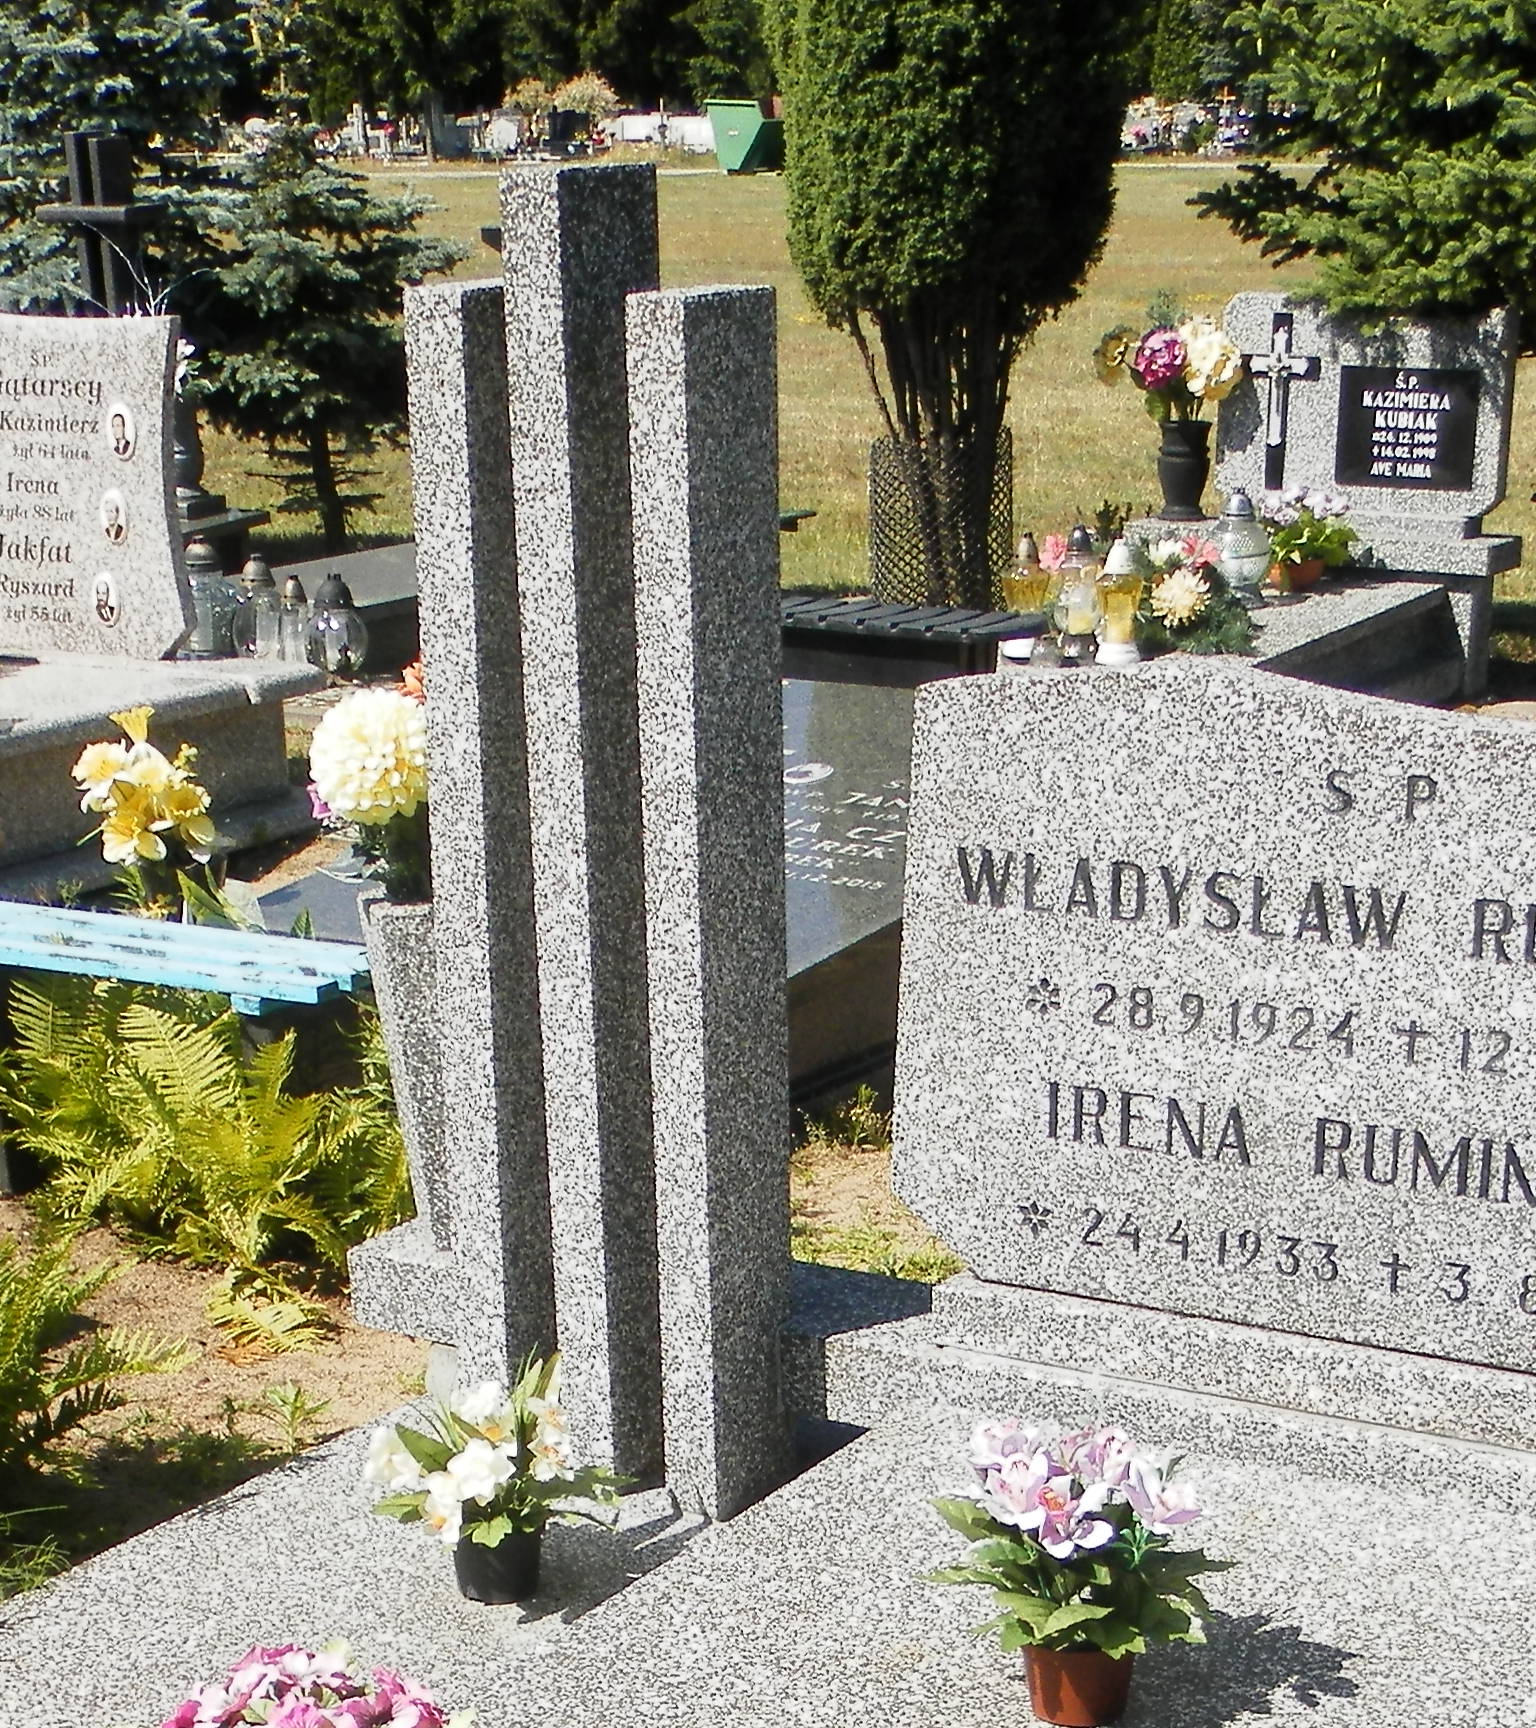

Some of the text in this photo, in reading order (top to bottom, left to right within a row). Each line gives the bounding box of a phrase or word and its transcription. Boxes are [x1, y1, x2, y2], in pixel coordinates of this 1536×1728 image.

[1361, 390, 1452, 411] KAZIMIERA
[1374, 410, 1439, 431] KUBIAK
[1369, 461, 1432, 479] AVE MARIA
[7, 471, 59, 495] Irena
[1404, 773, 1440, 823] P
[957, 844, 1409, 951] WŁADYSŁAW
[1047, 1079, 1253, 1168] IRENA
